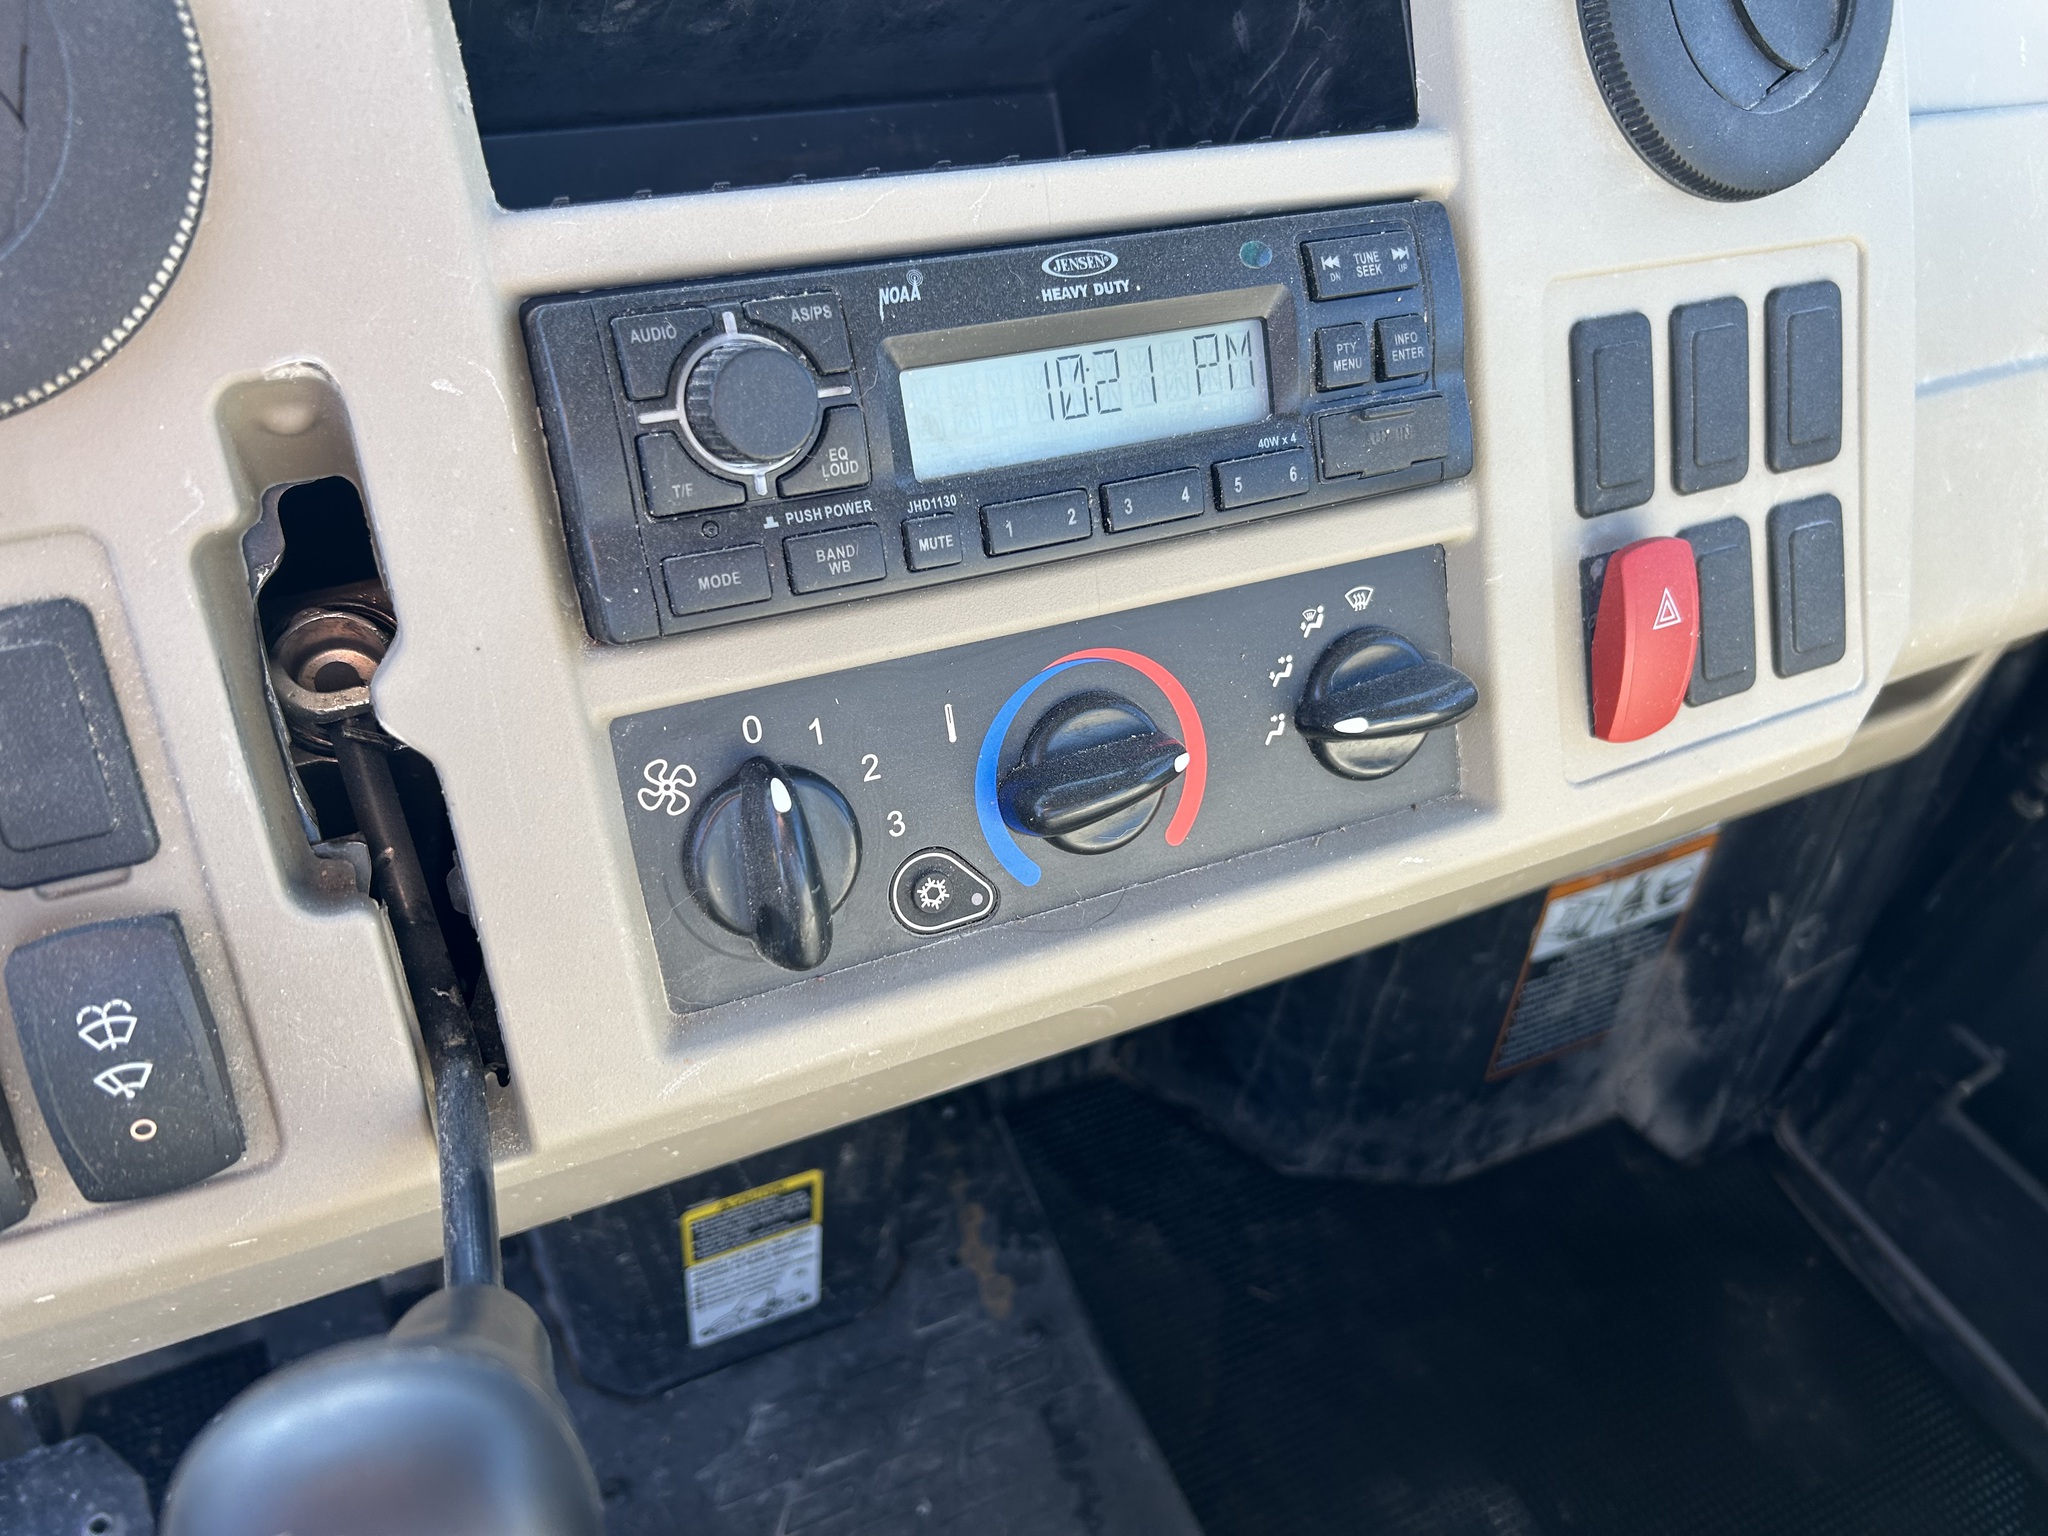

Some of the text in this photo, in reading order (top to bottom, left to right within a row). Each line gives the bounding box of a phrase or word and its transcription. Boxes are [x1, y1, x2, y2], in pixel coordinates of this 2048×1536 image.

[1353, 251, 1380, 265] TUNE
[1330, 272, 1341, 282] DN
[1356, 264, 1383, 278] SEEK
[1398, 263, 1408, 273] UP
[1041, 279, 1130, 302] HEAVY DUTY
[879, 284, 922, 321] NOAA
[791, 304, 832, 322] AS/PS
[630, 324, 677, 344] AUDIO
[1394, 332, 1418, 345] INFO
[1336, 342, 1357, 355] PTY
[1391, 346, 1424, 362] ENTER
[1333, 358, 1362, 372] MENU
[1043, 330, 1255, 421] 10:21 PM
[1258, 436, 1280, 449] 40W
[1290, 433, 1298, 444] 4
[829, 446, 848, 461] EQ
[822, 460, 859, 477] LOUD
[1234, 466, 1298, 493] 5 6
[672, 483, 694, 499] T/F
[907, 494, 957, 514] JHD1130
[1124, 486, 1190, 515] 3 4
[785, 500, 873, 525] PUSH POWER
[1005, 508, 1077, 538] 1 2
[919, 535, 954, 552] MUTE
[828, 560, 852, 575] WB
[698, 572, 742, 590] MODE
[742, 715, 762, 744] 0
[809, 718, 824, 745] 1
[861, 754, 881, 782] 2
[887, 811, 906, 837] 3
